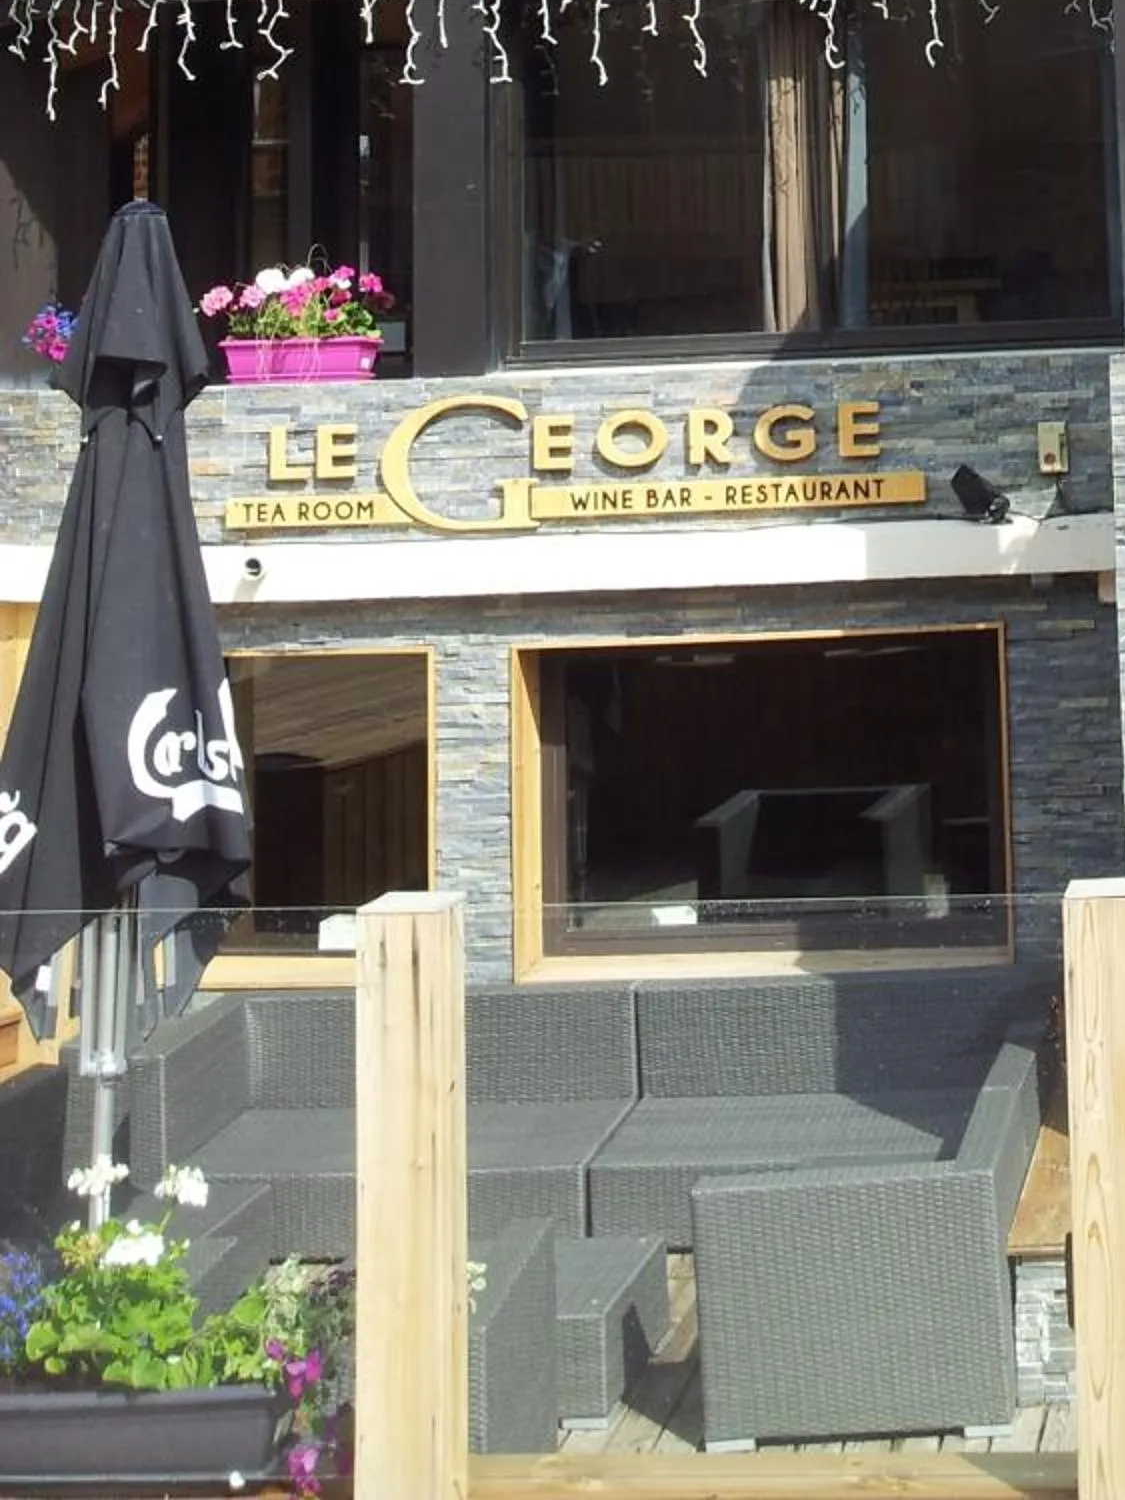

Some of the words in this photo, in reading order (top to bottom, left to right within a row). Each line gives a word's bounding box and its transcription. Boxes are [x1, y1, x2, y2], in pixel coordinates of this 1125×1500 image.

[270, 424, 358, 480] LE
[381, 395, 881, 531] GEORGE
[242, 503, 285, 522] TEA
[298, 500, 374, 520] ROOM
[570, 489, 633, 511] WINE
[646, 487, 692, 509] BAR
[725, 478, 885, 505] RESTAURANT
